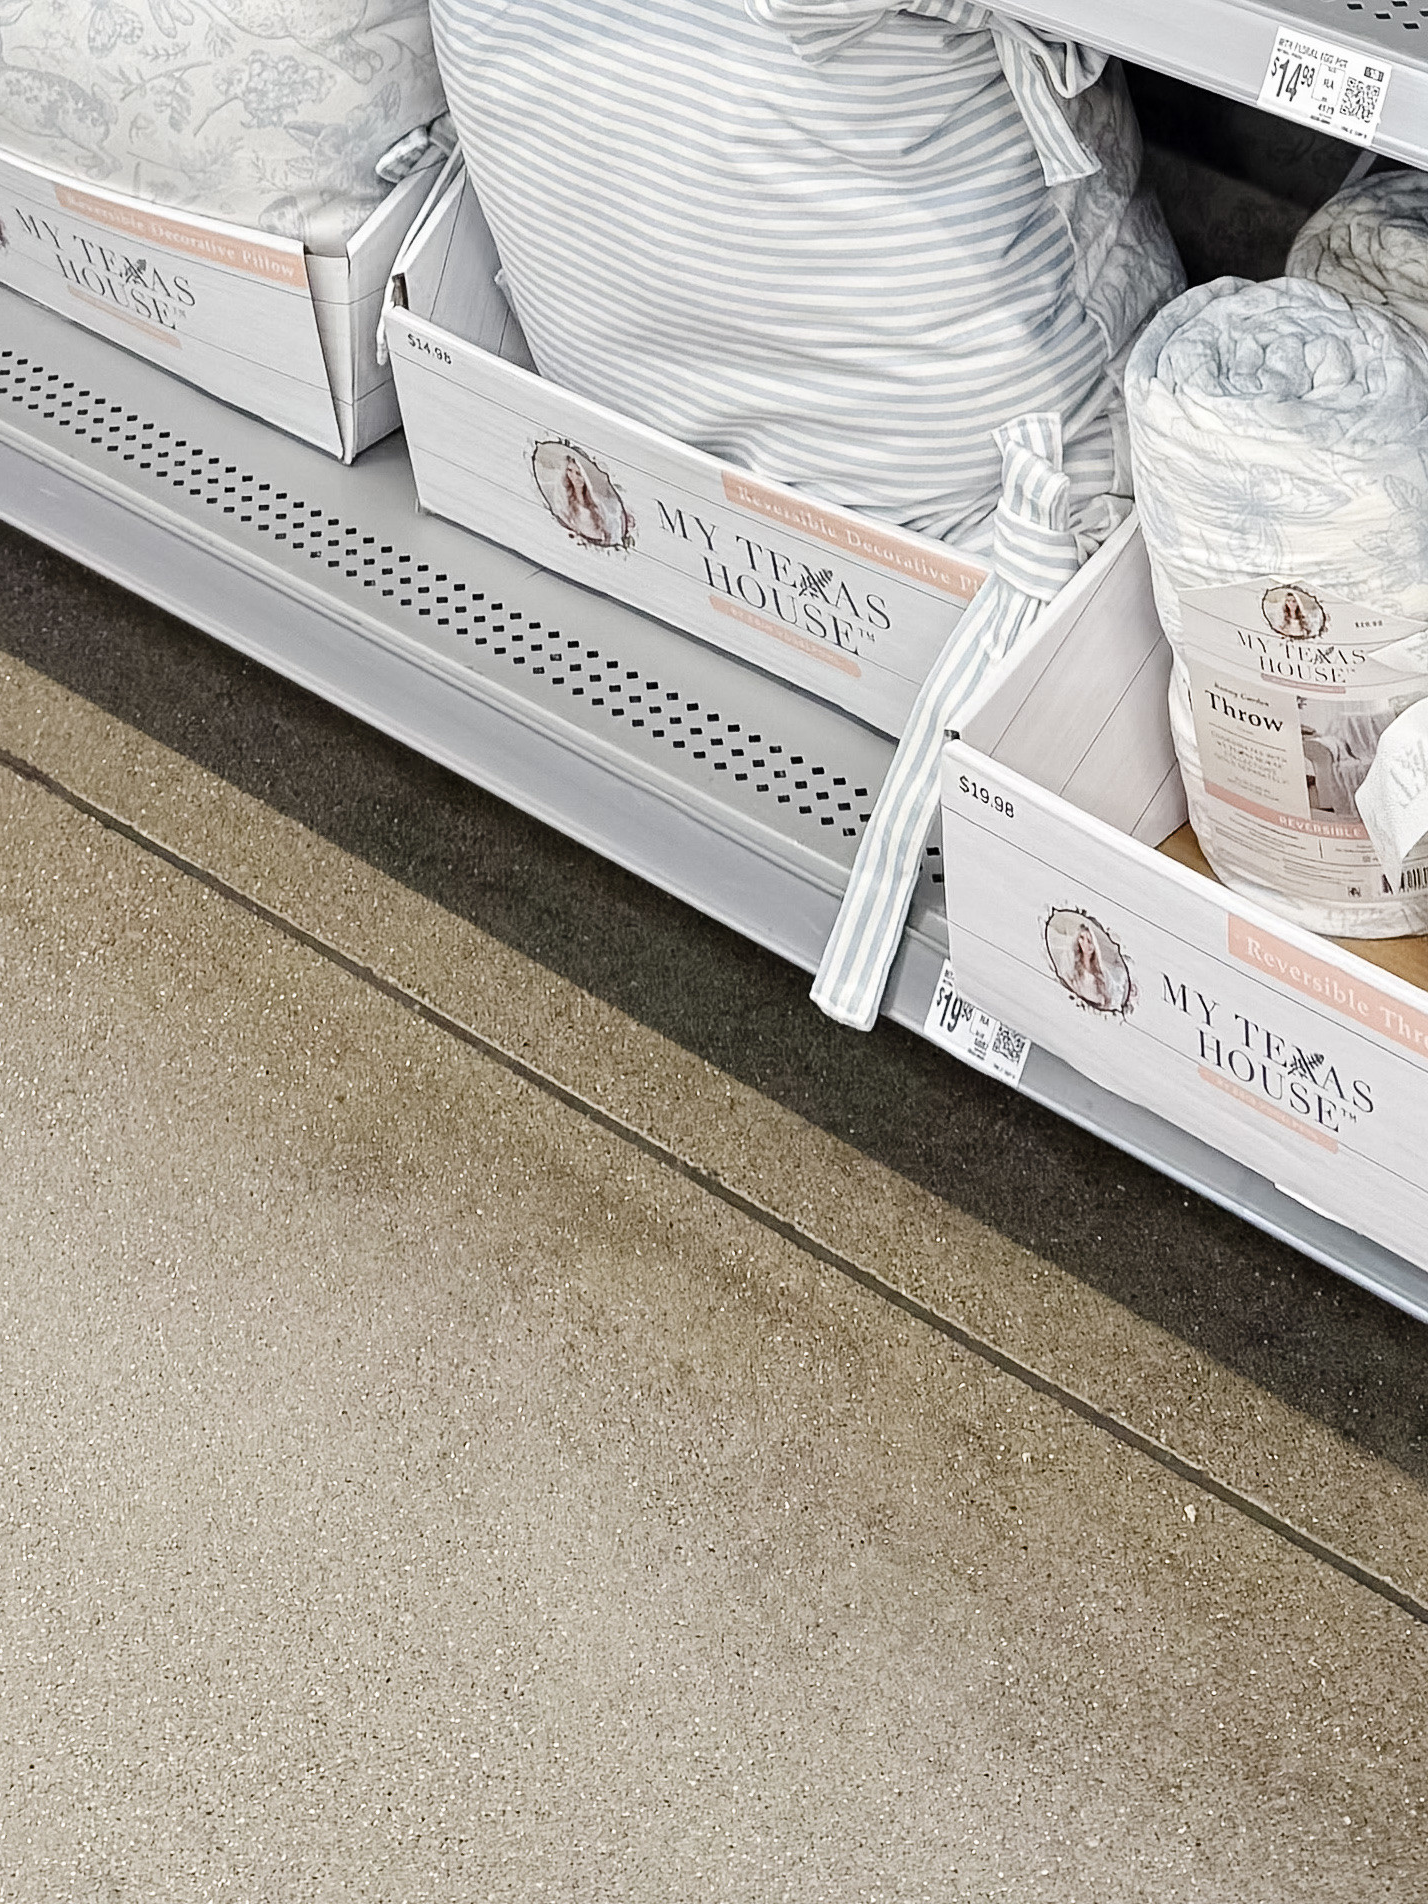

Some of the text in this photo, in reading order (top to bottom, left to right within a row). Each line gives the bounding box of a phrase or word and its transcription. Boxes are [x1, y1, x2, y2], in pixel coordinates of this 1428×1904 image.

[14, 207, 197, 308] MY TEXAS
[406, 331, 453, 366] $14.98
[655, 498, 892, 631] MY TEXAS
[845, 524, 953, 585] Decorative
[1236, 630, 1367, 667] MY TEXAS
[1204, 689, 1284, 732] Throw
[957, 774, 1016, 820] $19.98
[1278, 815, 1362, 839] REVERSIBLE
[1247, 935, 1370, 1017] Reversible
[1161, 972, 1376, 1117] MY TEXAS
